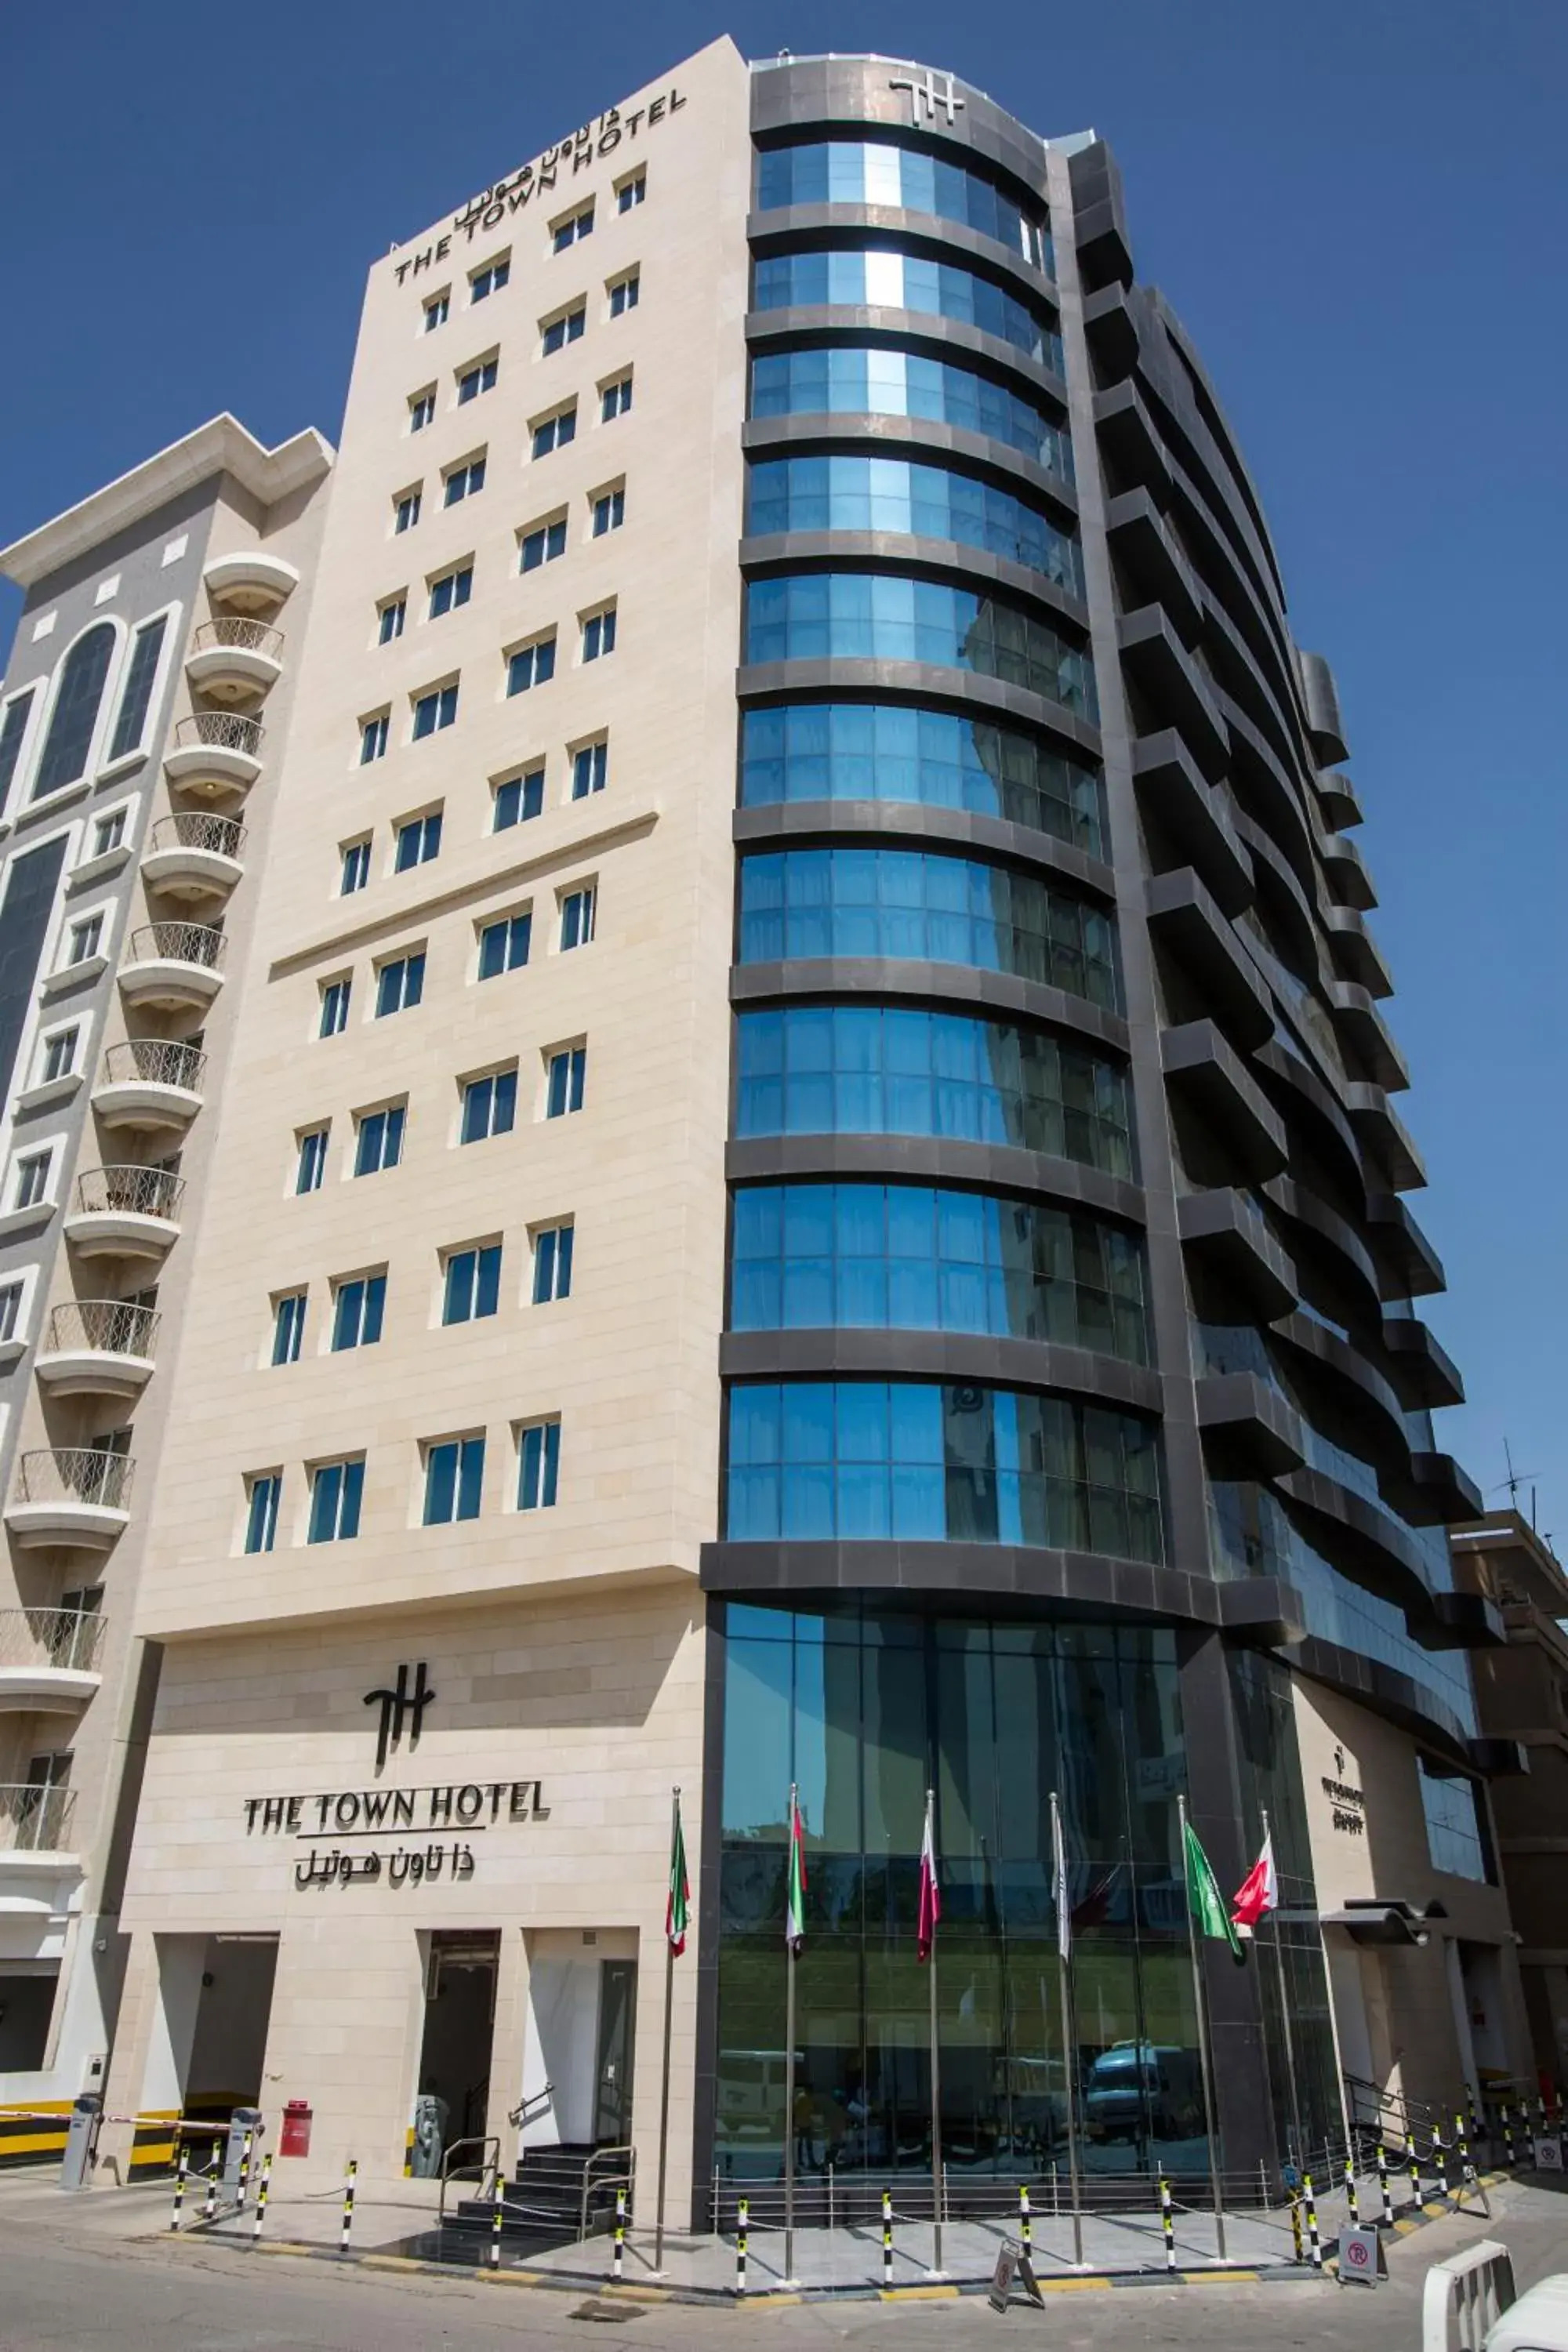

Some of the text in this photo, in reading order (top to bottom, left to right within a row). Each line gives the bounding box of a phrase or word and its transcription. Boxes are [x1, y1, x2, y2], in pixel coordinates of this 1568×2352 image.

[394, 89, 687, 286] THE TOWN HOTEL
[245, 1781, 550, 1831] THE TOWN HOTEL
[390, 1844, 444, 1879] تاون
